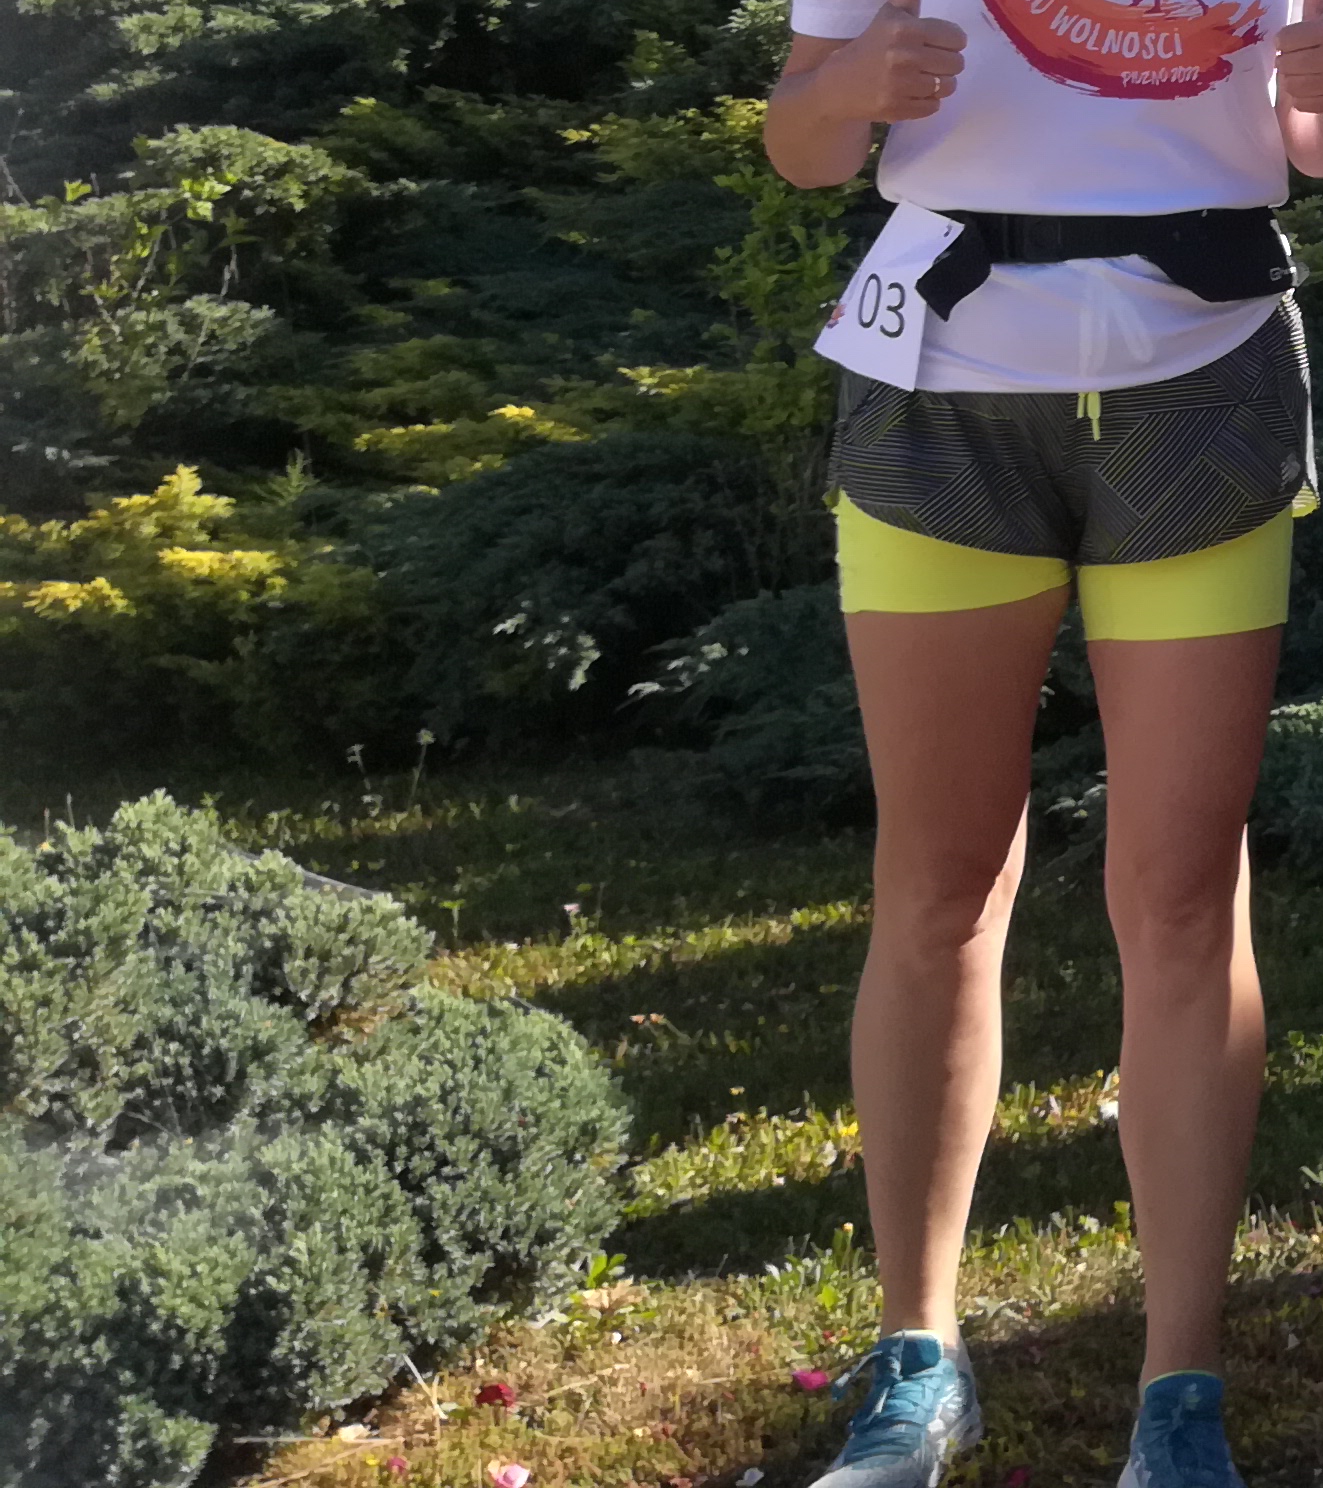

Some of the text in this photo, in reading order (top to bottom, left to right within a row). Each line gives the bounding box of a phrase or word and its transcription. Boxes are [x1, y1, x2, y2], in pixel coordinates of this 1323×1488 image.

[1050, 5, 1183, 60] WOLNOŚCI
[1170, 65, 1200, 83] 2022
[858, 273, 906, 338] 03
